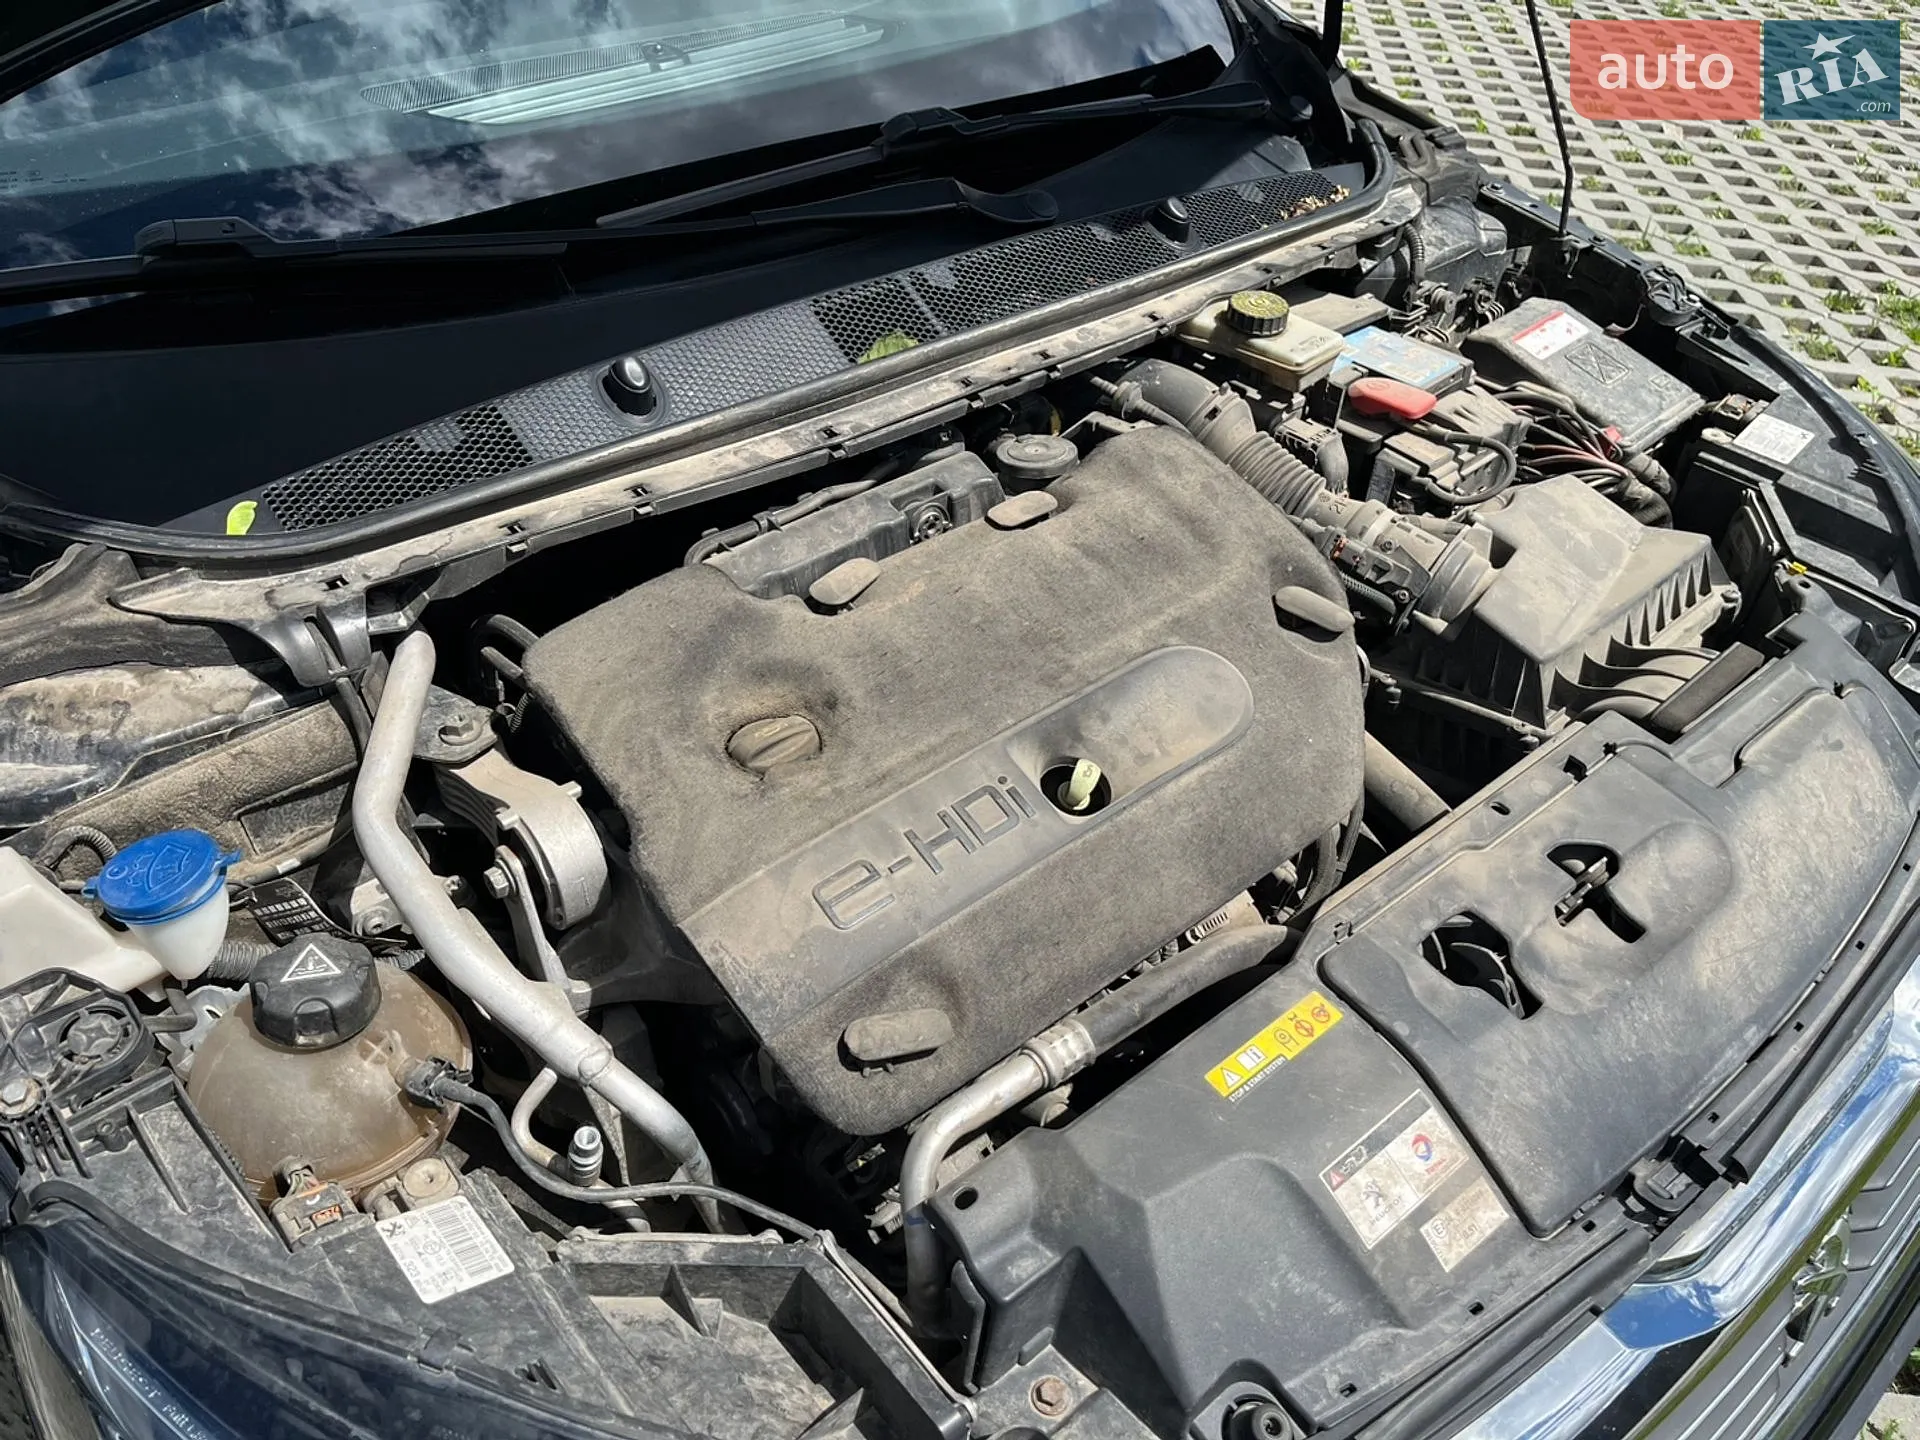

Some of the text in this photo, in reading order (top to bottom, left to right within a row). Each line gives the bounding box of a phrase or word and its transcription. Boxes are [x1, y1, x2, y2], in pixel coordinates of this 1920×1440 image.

[812, 775, 1036, 931] e-HDi
[1229, 1087, 1245, 1103] STOP
[1247, 1070, 1267, 1088] START
[1264, 1055, 1287, 1075] SYSTEM
